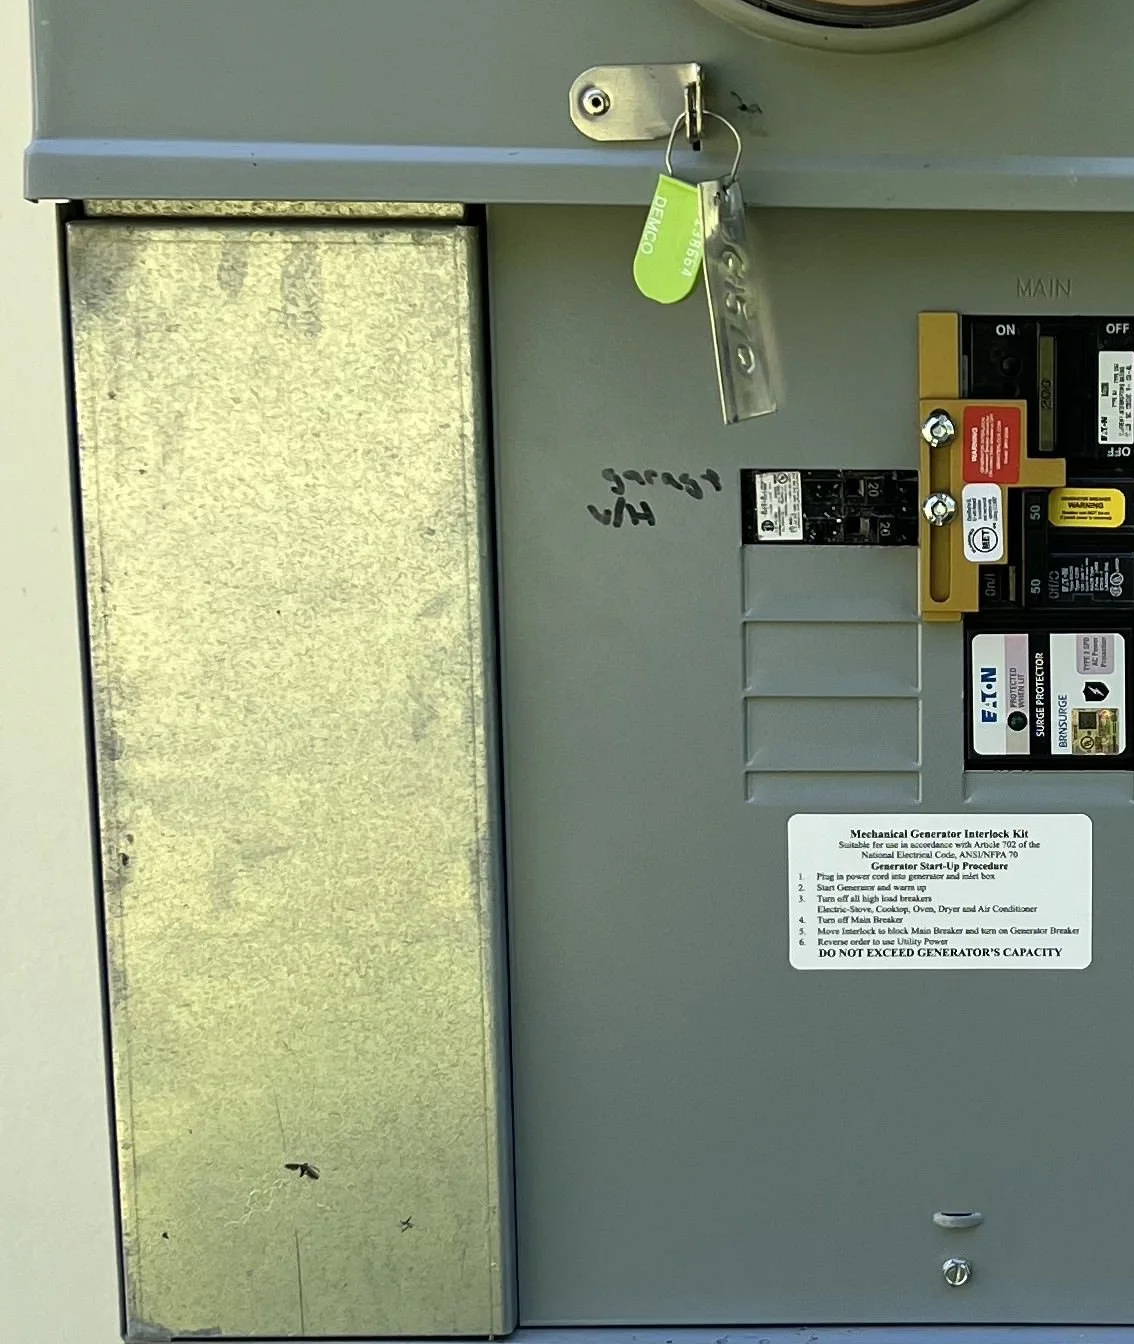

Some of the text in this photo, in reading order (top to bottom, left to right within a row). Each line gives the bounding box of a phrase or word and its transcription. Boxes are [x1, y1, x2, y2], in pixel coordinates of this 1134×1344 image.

[642, 194, 668, 256] DEMCO
[1016, 277, 1072, 298] MAIN
[996, 324, 1016, 336] ON
[1106, 323, 1130, 334] OFF
[1107, 447, 1131, 458] OFF
[868, 482, 880, 497] 20
[1030, 504, 1040, 520] 50
[880, 521, 890, 536] 20
[1030, 579, 1041, 594] 50
[980, 668, 998, 722] EATON
[1035, 652, 1045, 736] SURGE PROTECTOR
[1058, 694, 1068, 748] BRNSURGE
[850, 830, 1028, 838] Mechanical Generator Interlock Kit
[935, 851, 957, 859] Code,
[871, 862, 1008, 872] Generator Start-Up Procedure
[863, 895, 879, 904] high
[897, 938, 921, 946] Utility
[819, 948, 1062, 957] DO NOT EXCEED GENERATOR'S CAPACITY
